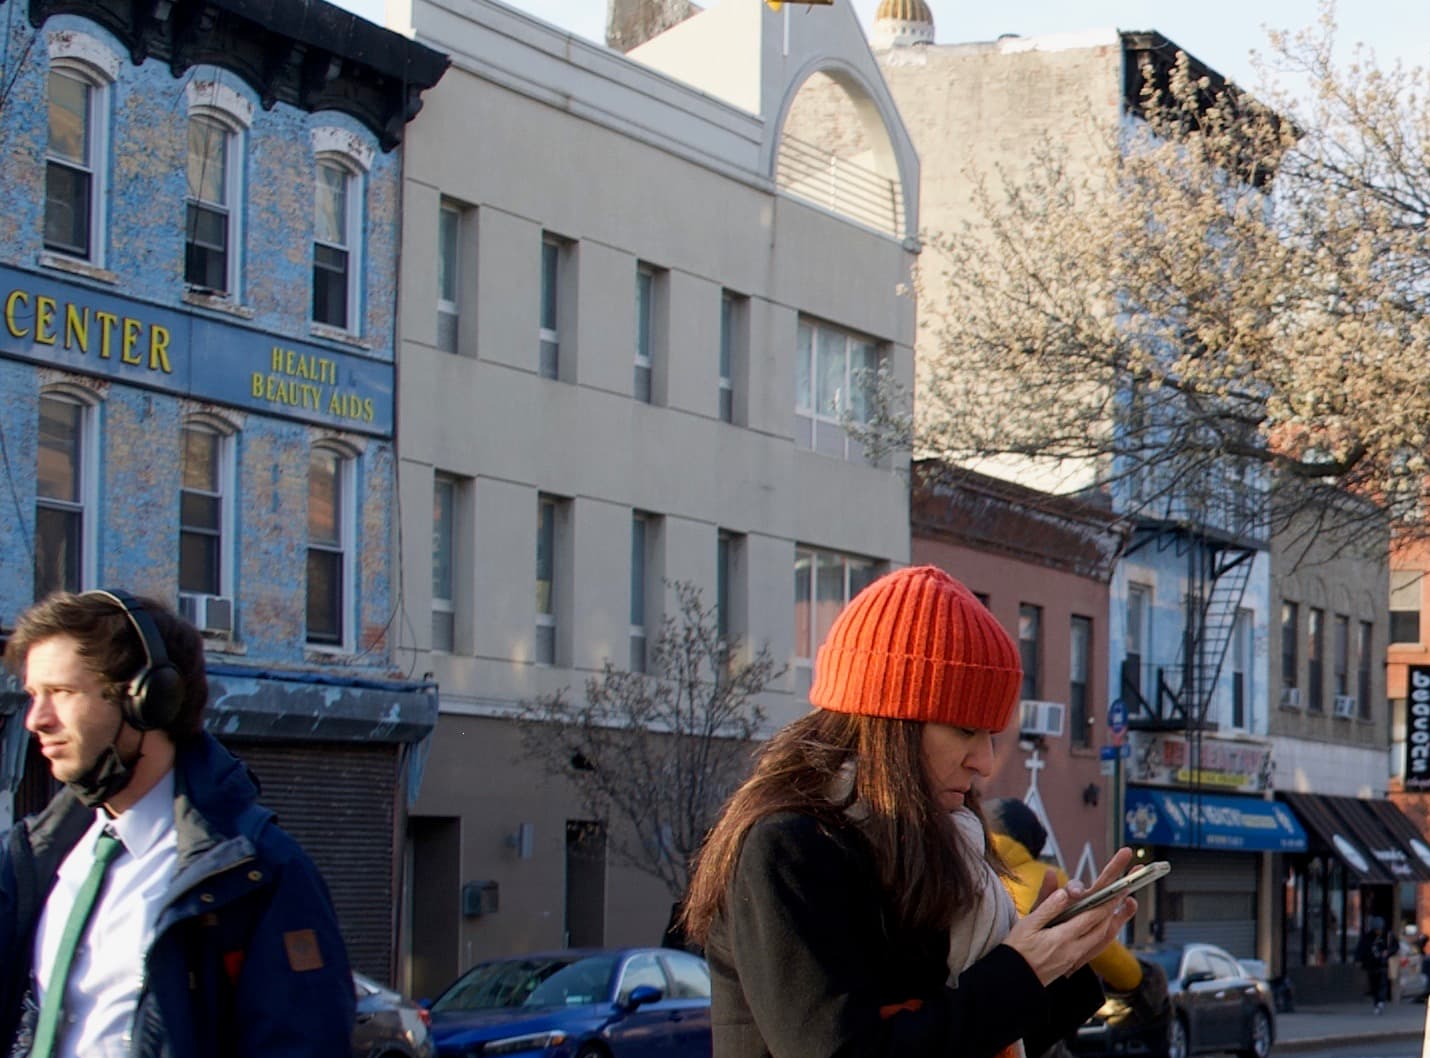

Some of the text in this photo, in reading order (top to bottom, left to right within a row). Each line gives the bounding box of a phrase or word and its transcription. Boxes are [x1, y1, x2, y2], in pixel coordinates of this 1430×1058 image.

[4, 289, 172, 373] CENTER
[252, 372, 374, 423] BEAUTY AIDS
